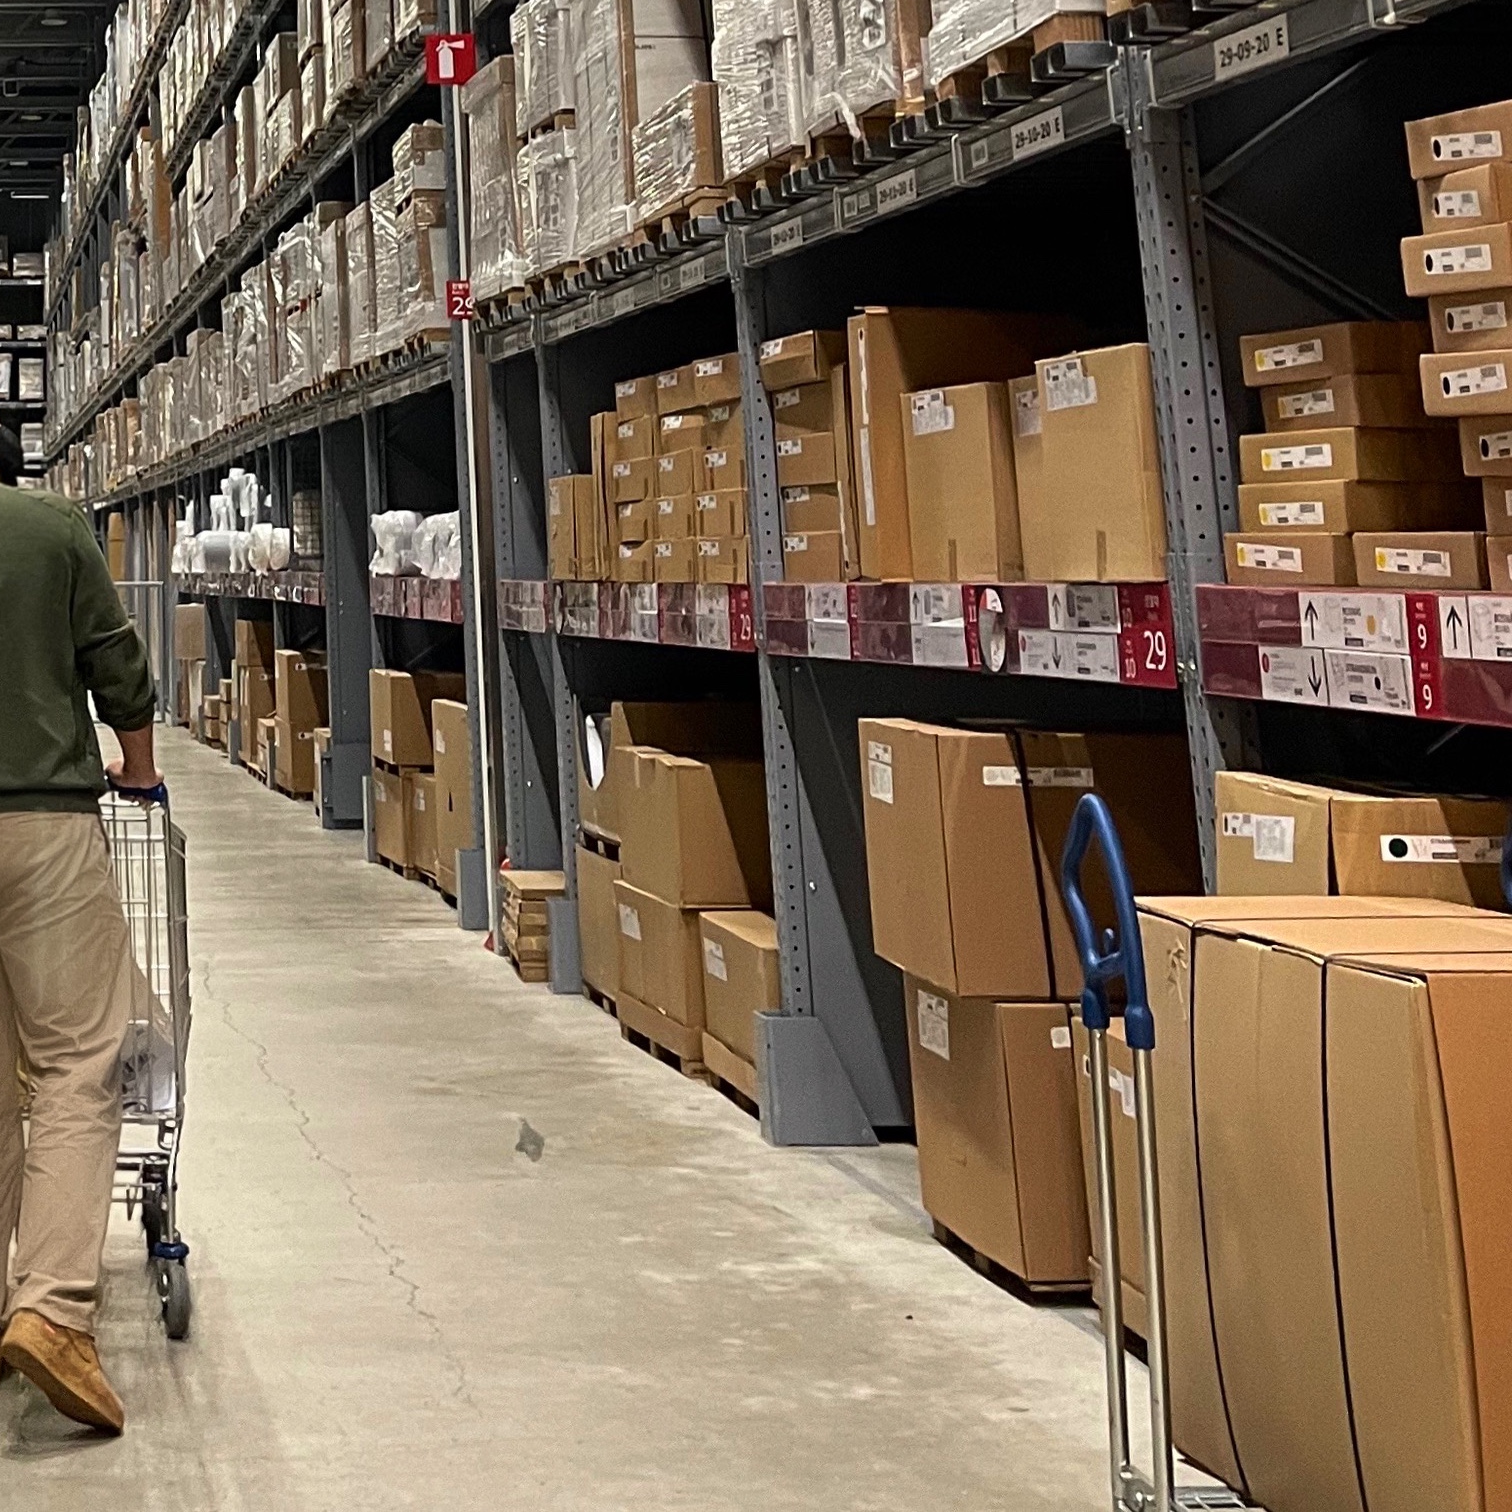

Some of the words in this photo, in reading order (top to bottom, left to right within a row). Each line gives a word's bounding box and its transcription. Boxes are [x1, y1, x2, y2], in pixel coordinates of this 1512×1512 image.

[1219, 32, 1270, 68] 29-09-20
[1276, 27, 1284, 46] E
[1054, 116, 1060, 133] E
[1144, 630, 1166, 670] 29
[1417, 624, 1427, 650] 9
[1422, 684, 1433, 710] 9
